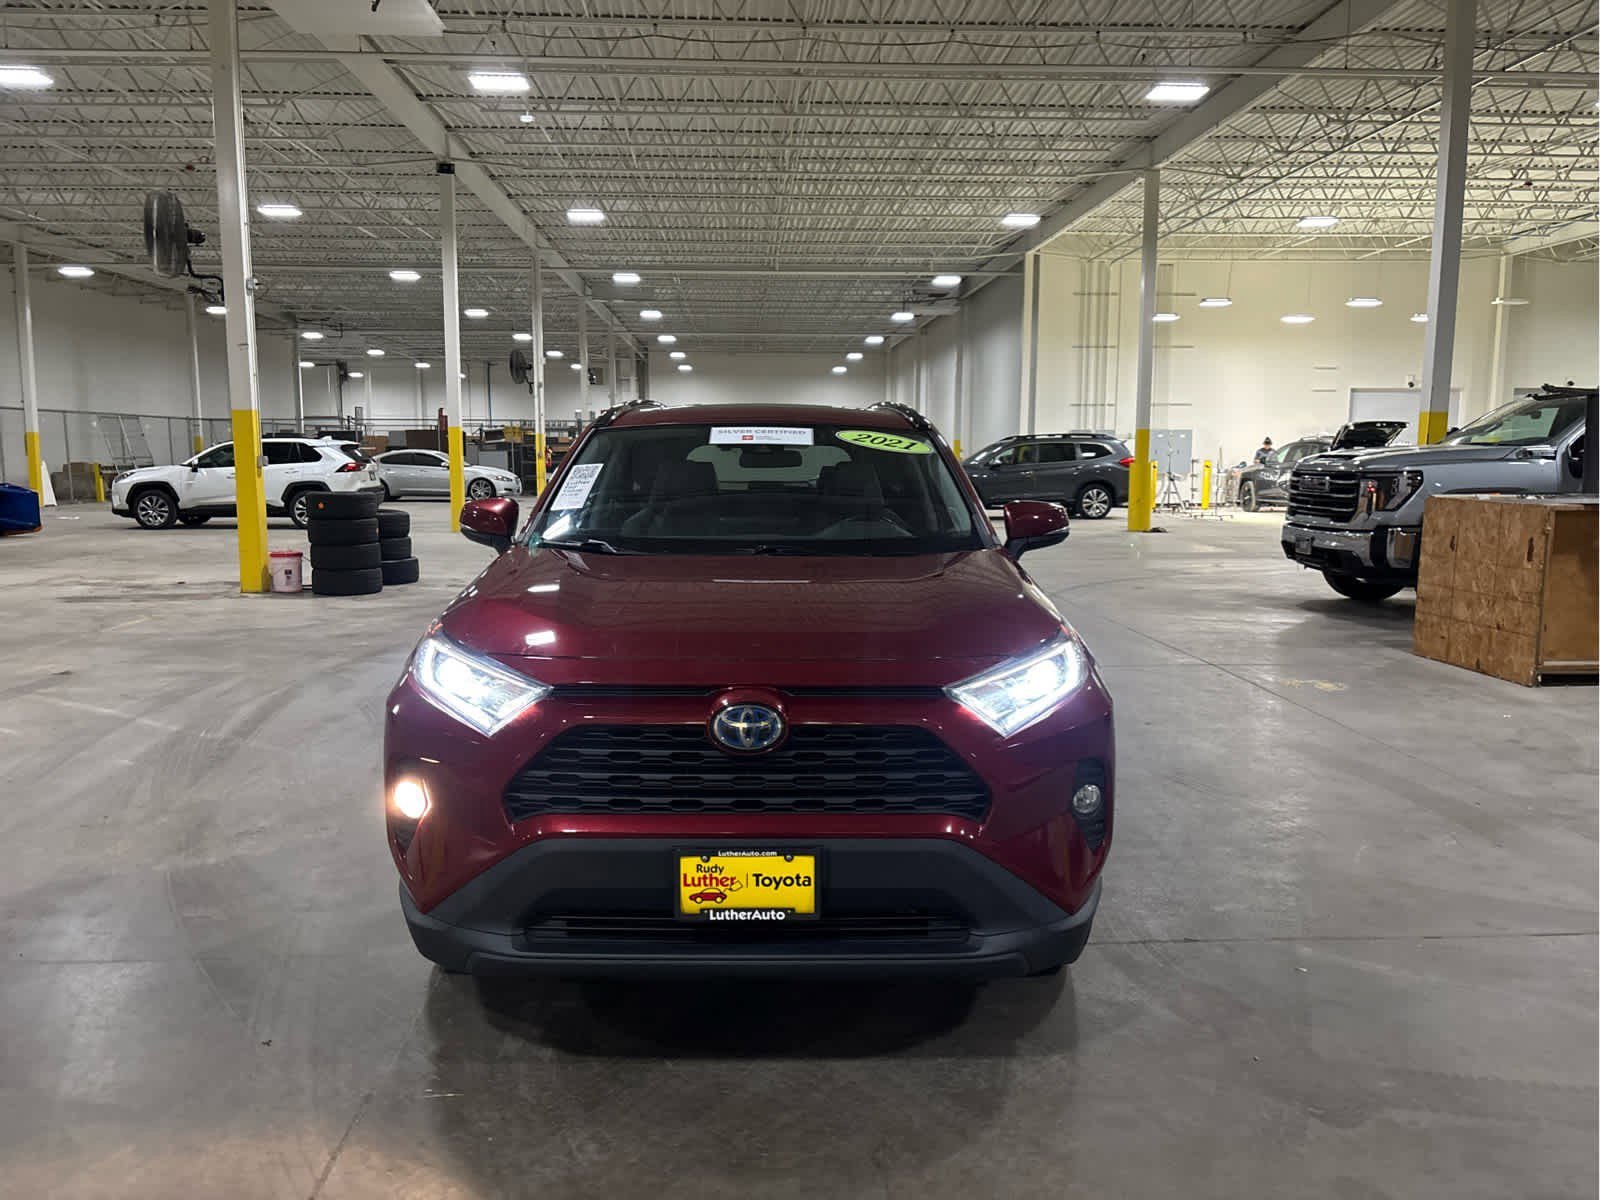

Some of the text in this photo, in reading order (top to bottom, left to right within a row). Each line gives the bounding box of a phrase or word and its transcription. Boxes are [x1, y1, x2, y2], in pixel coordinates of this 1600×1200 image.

[852, 433, 917, 450] 2021
[696, 864, 725, 875] Rudy
[683, 873, 812, 890] Luther Toyota
[709, 909, 786, 921] LutherAuto
